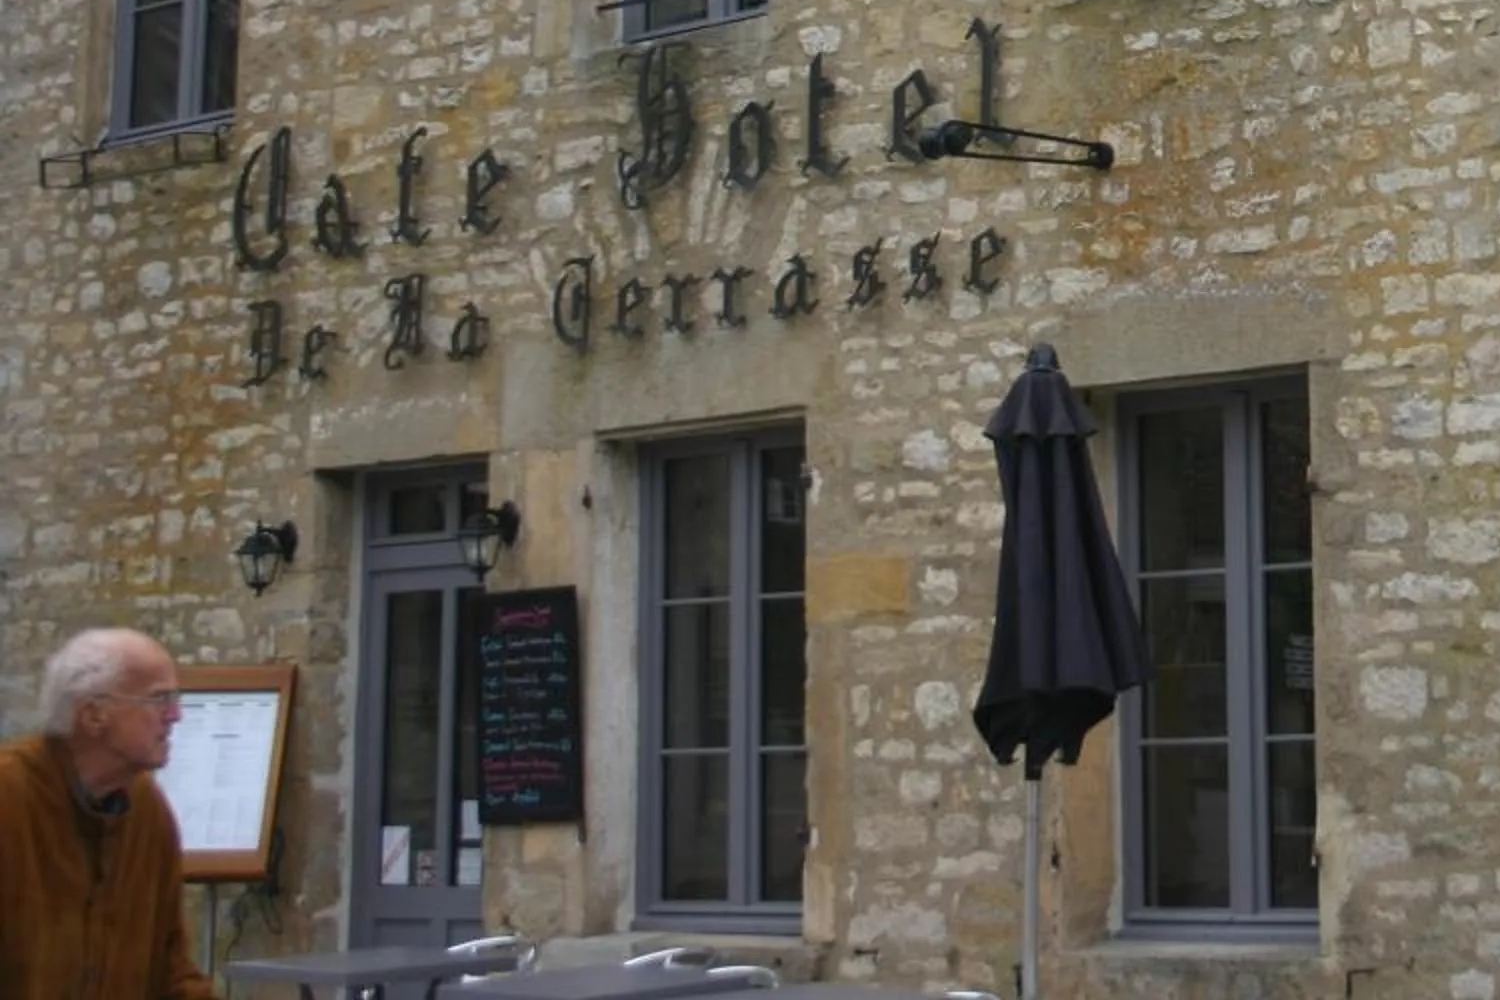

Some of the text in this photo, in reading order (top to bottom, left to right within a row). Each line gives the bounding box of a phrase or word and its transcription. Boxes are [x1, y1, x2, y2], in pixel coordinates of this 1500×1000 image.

[618, 17, 1015, 210] Hotel
[244, 225, 1005, 388] De La Terrasse
